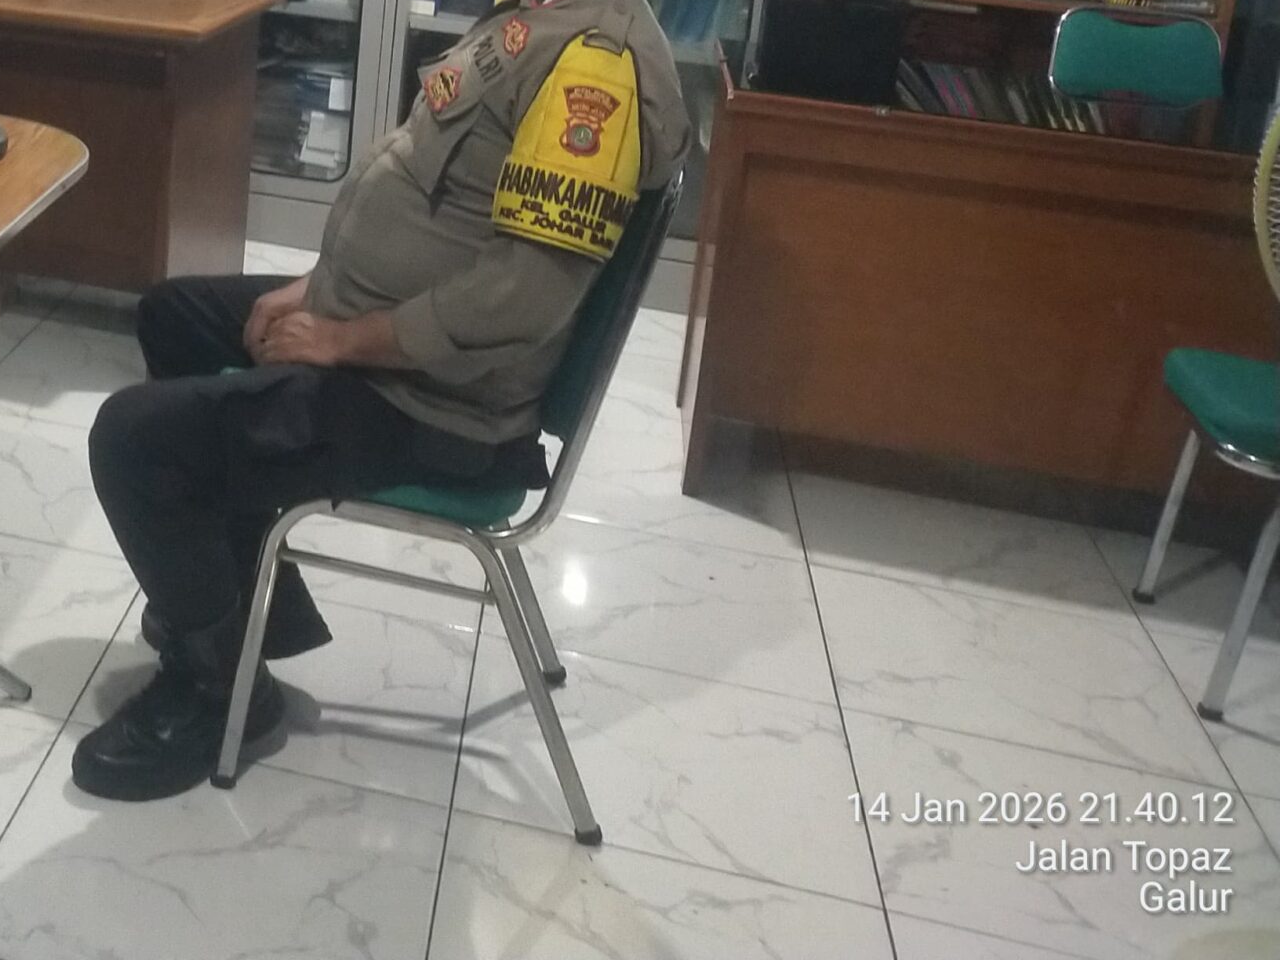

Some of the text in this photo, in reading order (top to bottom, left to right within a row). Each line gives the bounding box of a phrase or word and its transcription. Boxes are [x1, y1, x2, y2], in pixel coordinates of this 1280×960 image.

[499, 206, 524, 223] KEC.
[530, 216, 585, 240] JOHAR
[520, 198, 607, 233] KEL. GALUR
